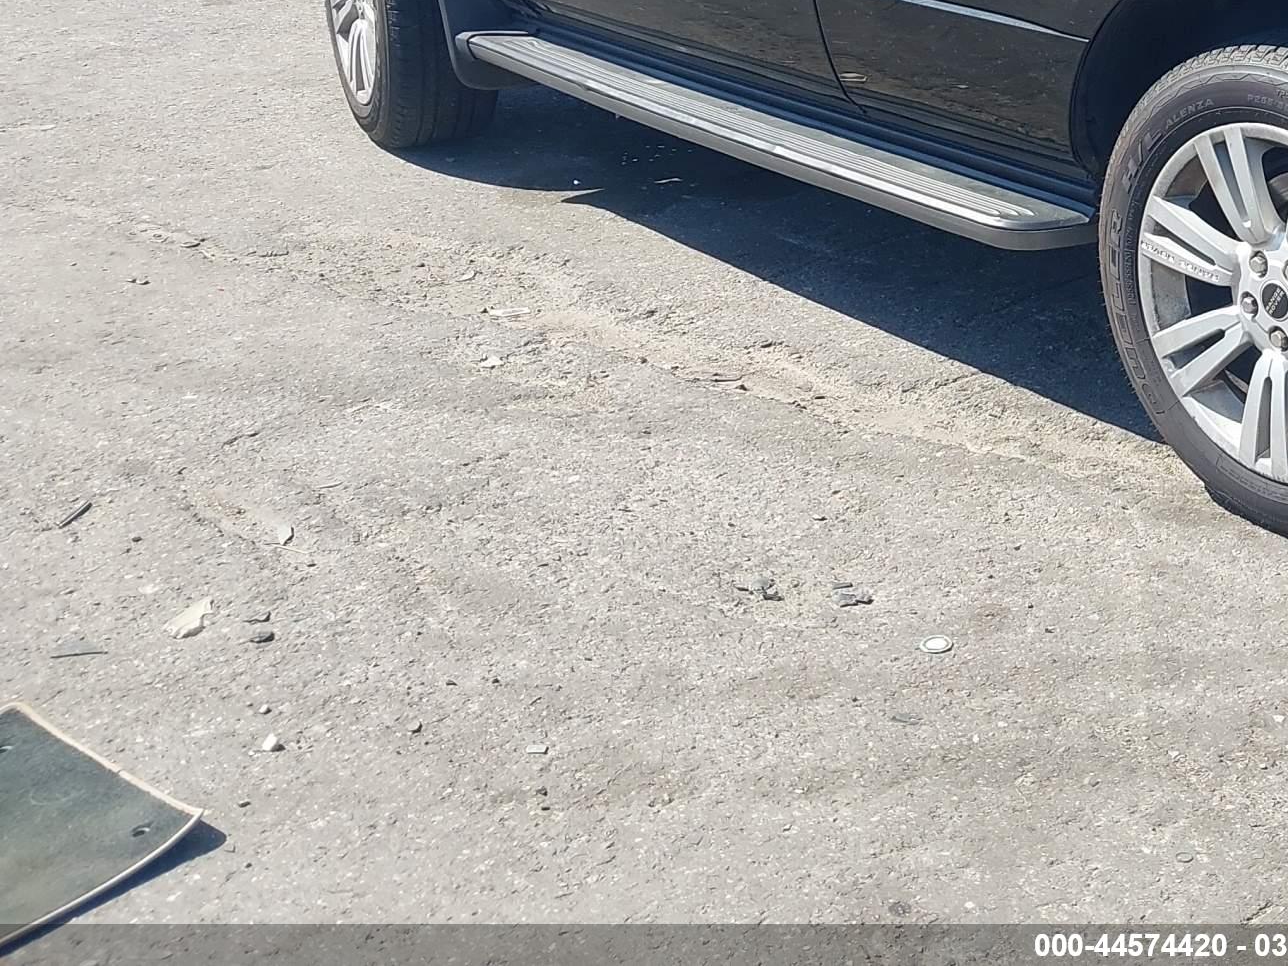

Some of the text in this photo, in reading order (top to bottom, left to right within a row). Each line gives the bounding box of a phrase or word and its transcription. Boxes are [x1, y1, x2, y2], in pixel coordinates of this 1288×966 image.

[1165, 97, 1215, 129] ALENZA
[1265, 287, 1282, 312] RANGE
[1268, 290, 1286, 316] ROVER
